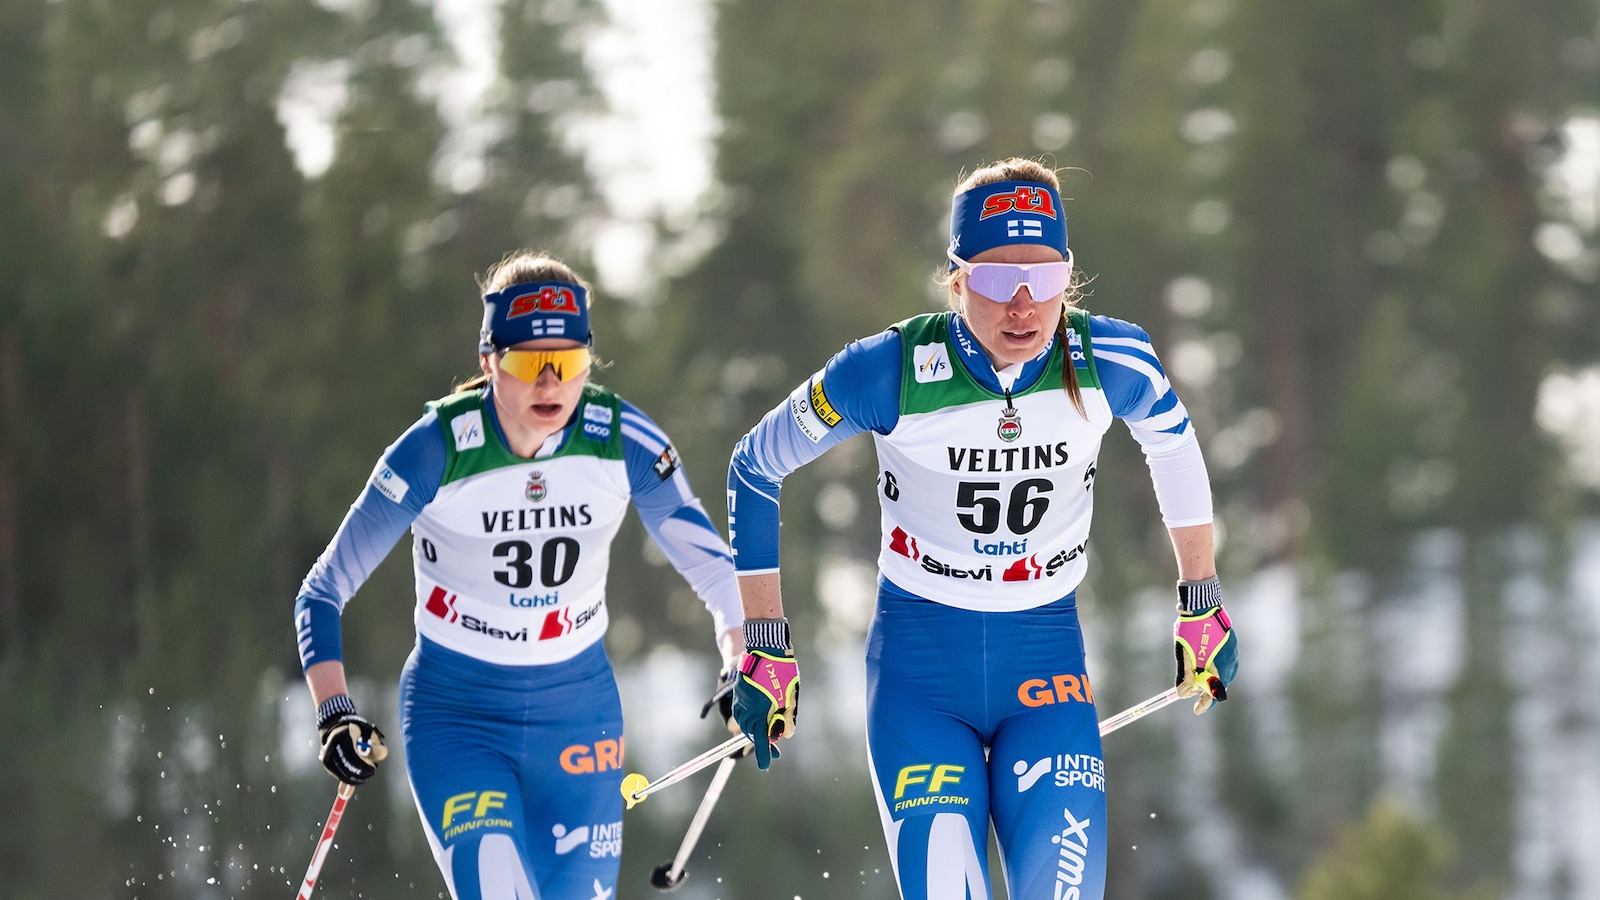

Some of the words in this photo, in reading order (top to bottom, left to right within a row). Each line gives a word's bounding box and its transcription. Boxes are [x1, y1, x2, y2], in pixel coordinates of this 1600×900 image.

[947, 441, 1069, 472] VELTINS
[481, 504, 592, 533] VELTINS
[956, 477, 1054, 535] 56
[973, 538, 1028, 556] Lahti
[492, 536, 580, 589] 30
[921, 554, 993, 582] Sievi
[509, 591, 559, 609] Lahti
[295, 606, 315, 665] FIN
[461, 613, 528, 642] Sievi
[1198, 622, 1212, 662] LEKI
[765, 663, 784, 702] LEKI
[1056, 753, 1105, 777] INTER
[894, 764, 965, 800] FF
[1054, 770, 1105, 793] SPORT
[442, 791, 507, 830] FF
[894, 795, 969, 813] FINNFORM
[444, 818, 513, 842] FINNFORM
[592, 820, 623, 841] INTE
